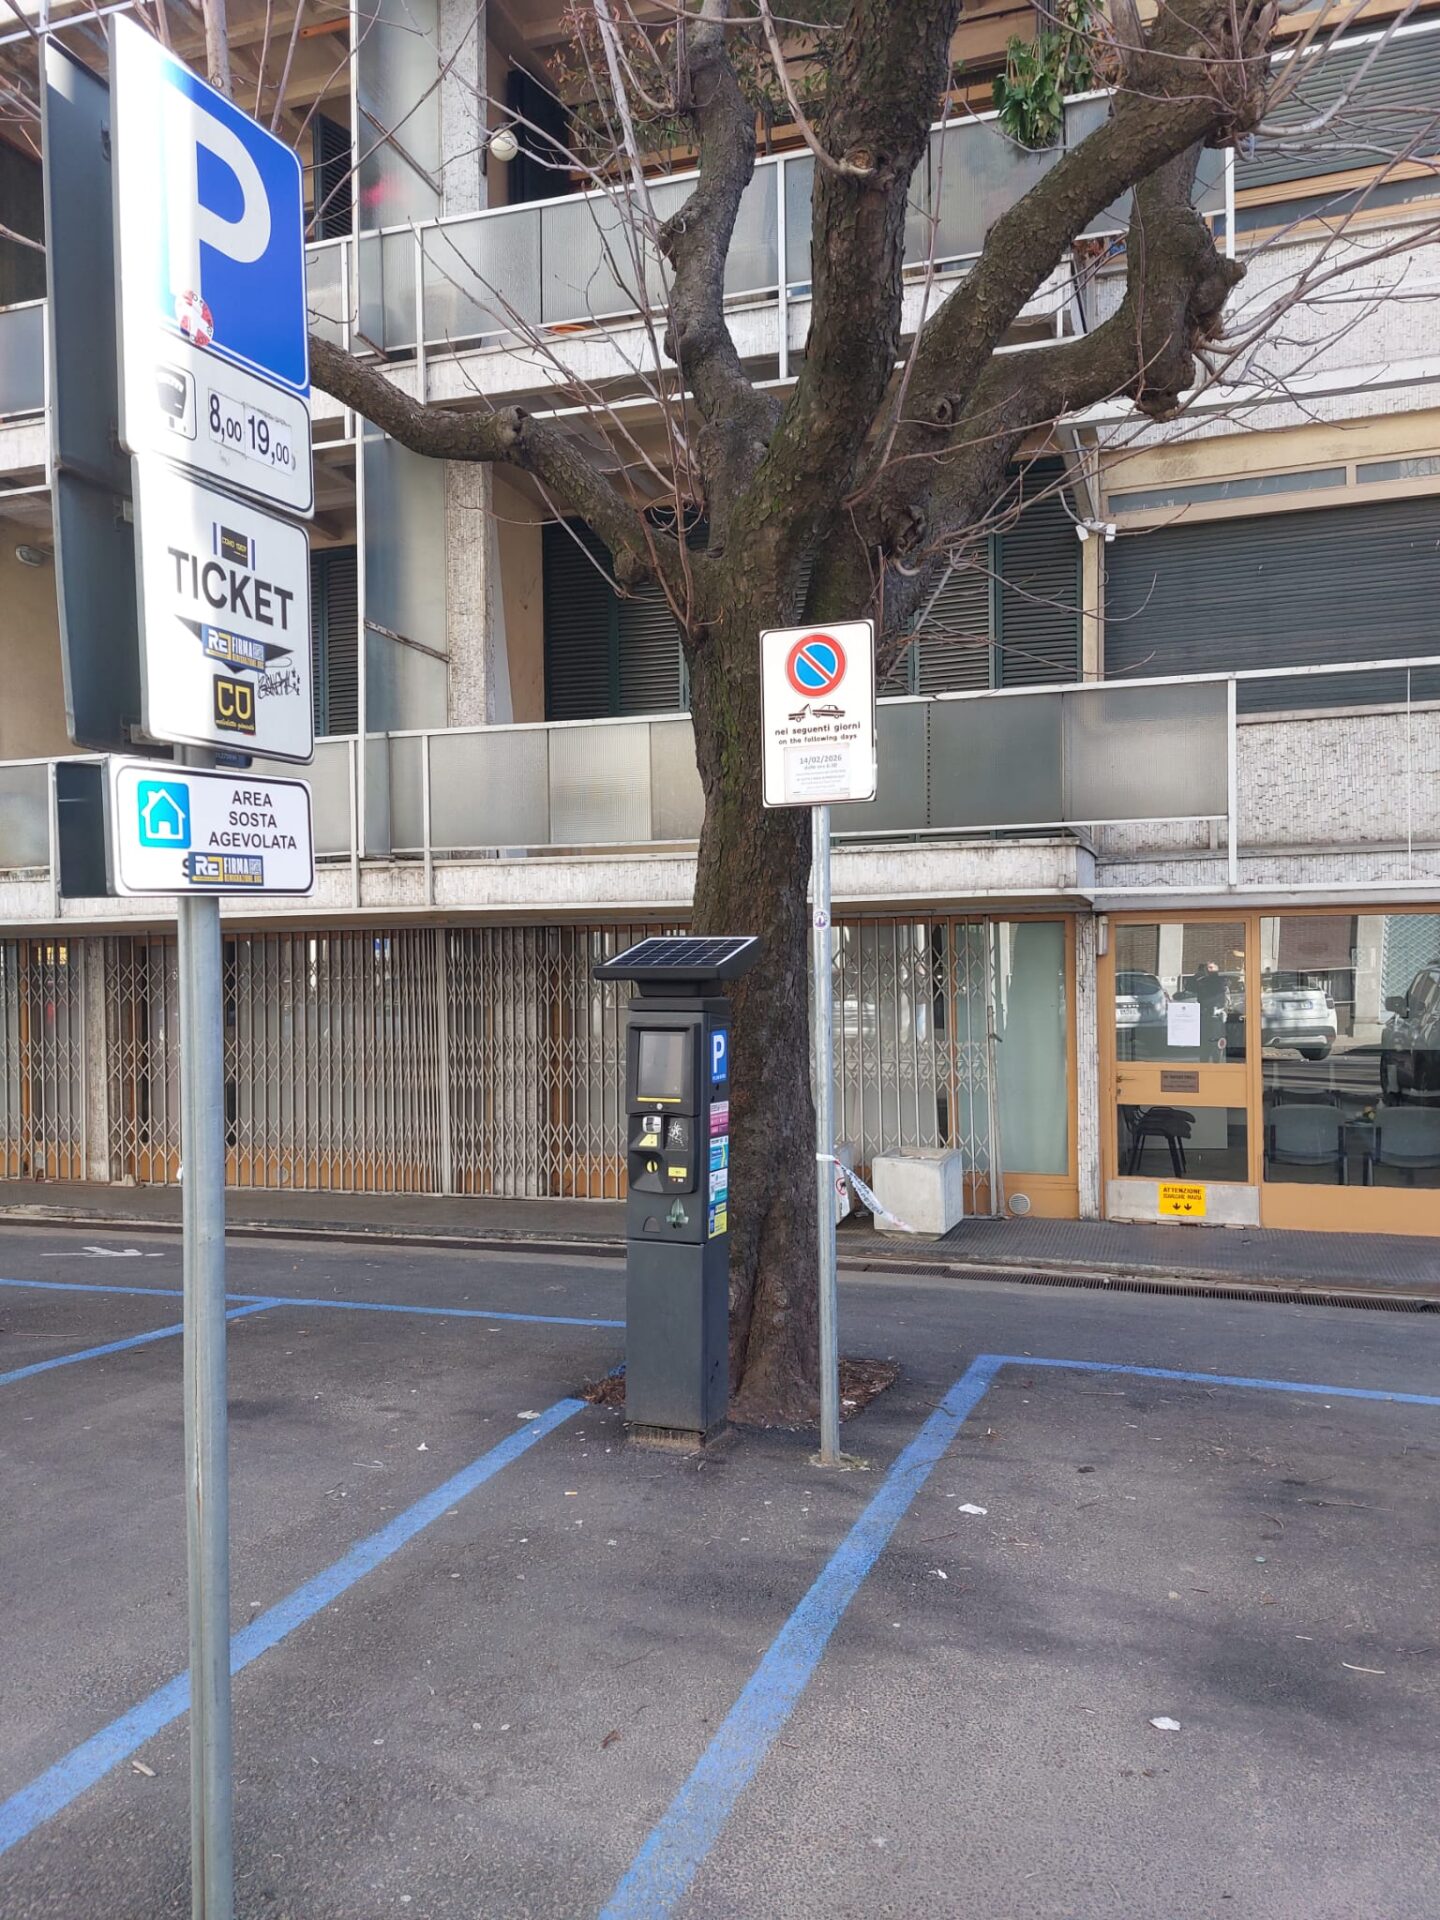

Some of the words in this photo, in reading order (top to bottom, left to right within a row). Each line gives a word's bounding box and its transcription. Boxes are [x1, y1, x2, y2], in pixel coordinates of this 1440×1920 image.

[167, 79, 272, 308] P
[210, 393, 242, 443] 8,00
[247, 414, 290, 465] 19,00
[167, 545, 294, 631] TICKET
[217, 680, 252, 720] CO
[775, 727, 788, 736] nei
[792, 723, 830, 735] seguenti
[834, 721, 861, 732] giorni
[804, 735, 837, 743] following
[232, 790, 273, 807] AREA
[229, 811, 278, 828] SOSTA
[209, 831, 298, 849] AGEVOLATA
[713, 1034, 725, 1073] P
